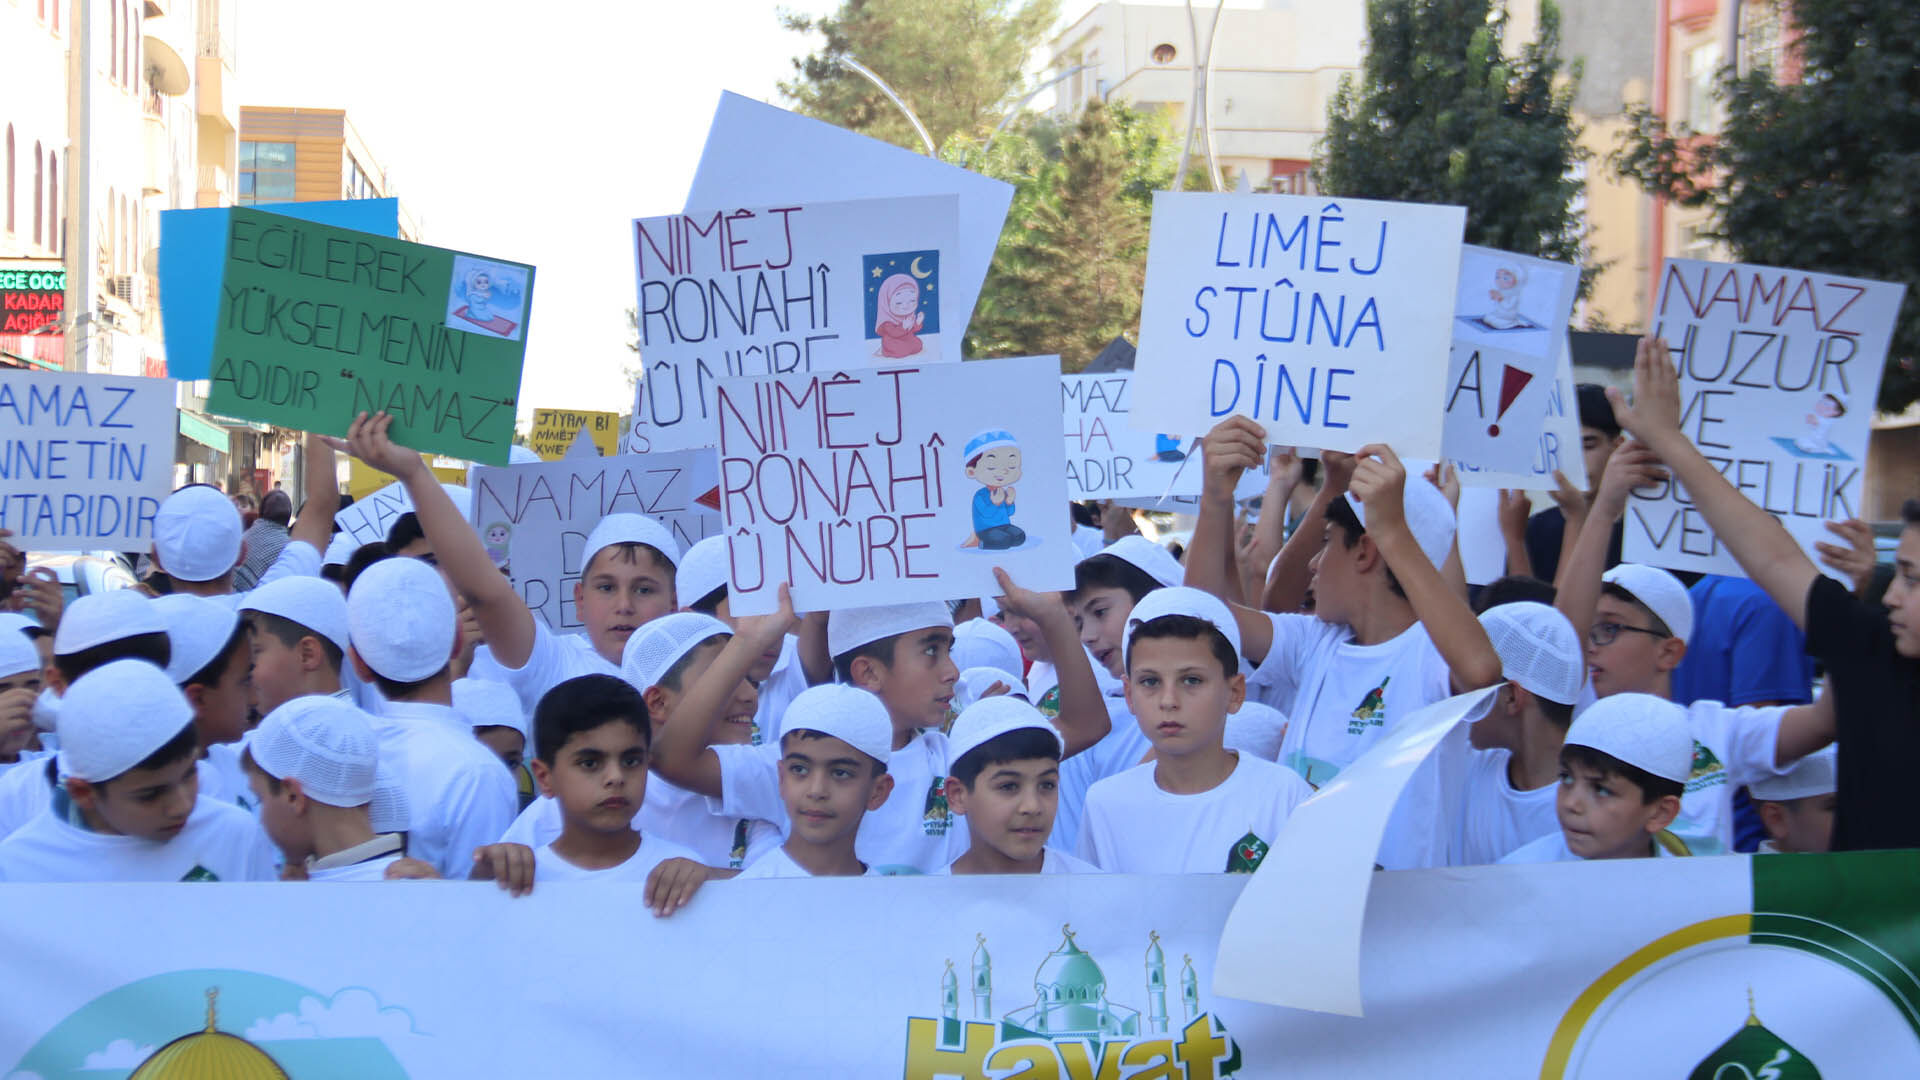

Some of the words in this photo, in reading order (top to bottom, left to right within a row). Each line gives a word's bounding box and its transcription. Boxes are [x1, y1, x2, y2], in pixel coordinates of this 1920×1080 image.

[231, 220, 426, 297] EĞİLEREK
[637, 207, 803, 279] NIMÊJ
[1216, 203, 1388, 275] LIMÊJ
[5, 292, 64, 311] KADAR
[224, 283, 466, 375] YÜKSELMENİN
[641, 263, 831, 346] RONAHÎ
[1186, 278, 1385, 351] STÛNA
[1659, 264, 1867, 336] NAMAZ
[214, 358, 320, 410] ADIDIR
[1211, 353, 1355, 428] DÎNE
[1655, 321, 1858, 394] HUZUR
[718, 368, 920, 456] NIMÊJ
[1061, 378, 1129, 413] MAZ
[478, 469, 687, 528] NAMAZ
[722, 432, 944, 526] RONAHÎ
[1066, 456, 1134, 492] ADIR
[785, 513, 939, 587] NÛRE
